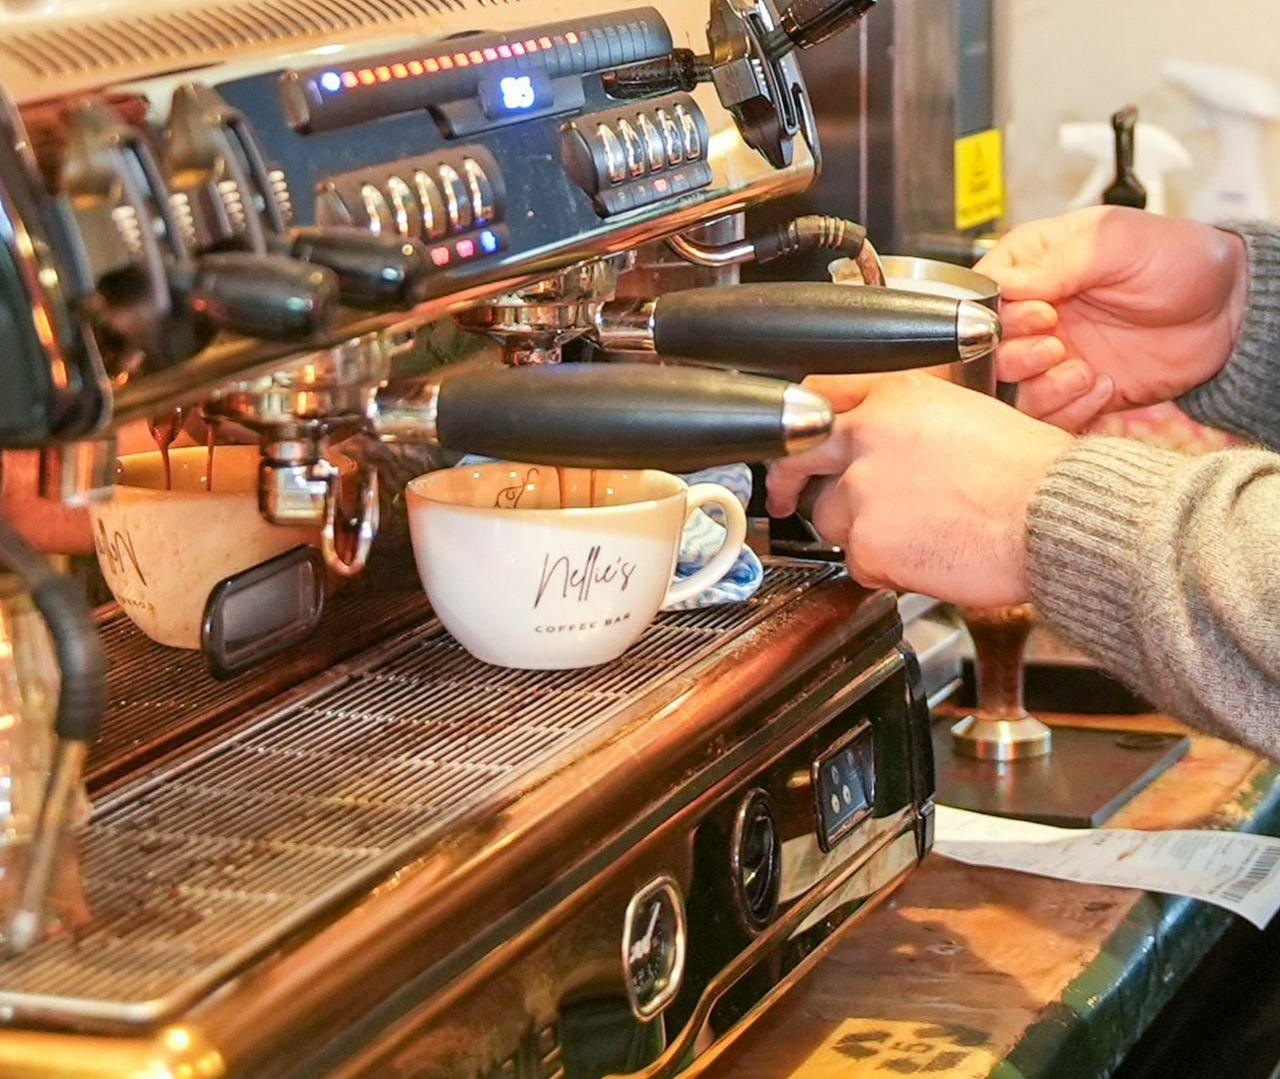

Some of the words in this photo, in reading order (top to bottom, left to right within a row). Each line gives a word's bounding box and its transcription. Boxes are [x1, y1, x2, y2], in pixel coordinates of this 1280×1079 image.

[533, 545, 637, 609] Nellie's
[535, 621, 597, 634] COFFEE
[604, 612, 631, 626] BAR
